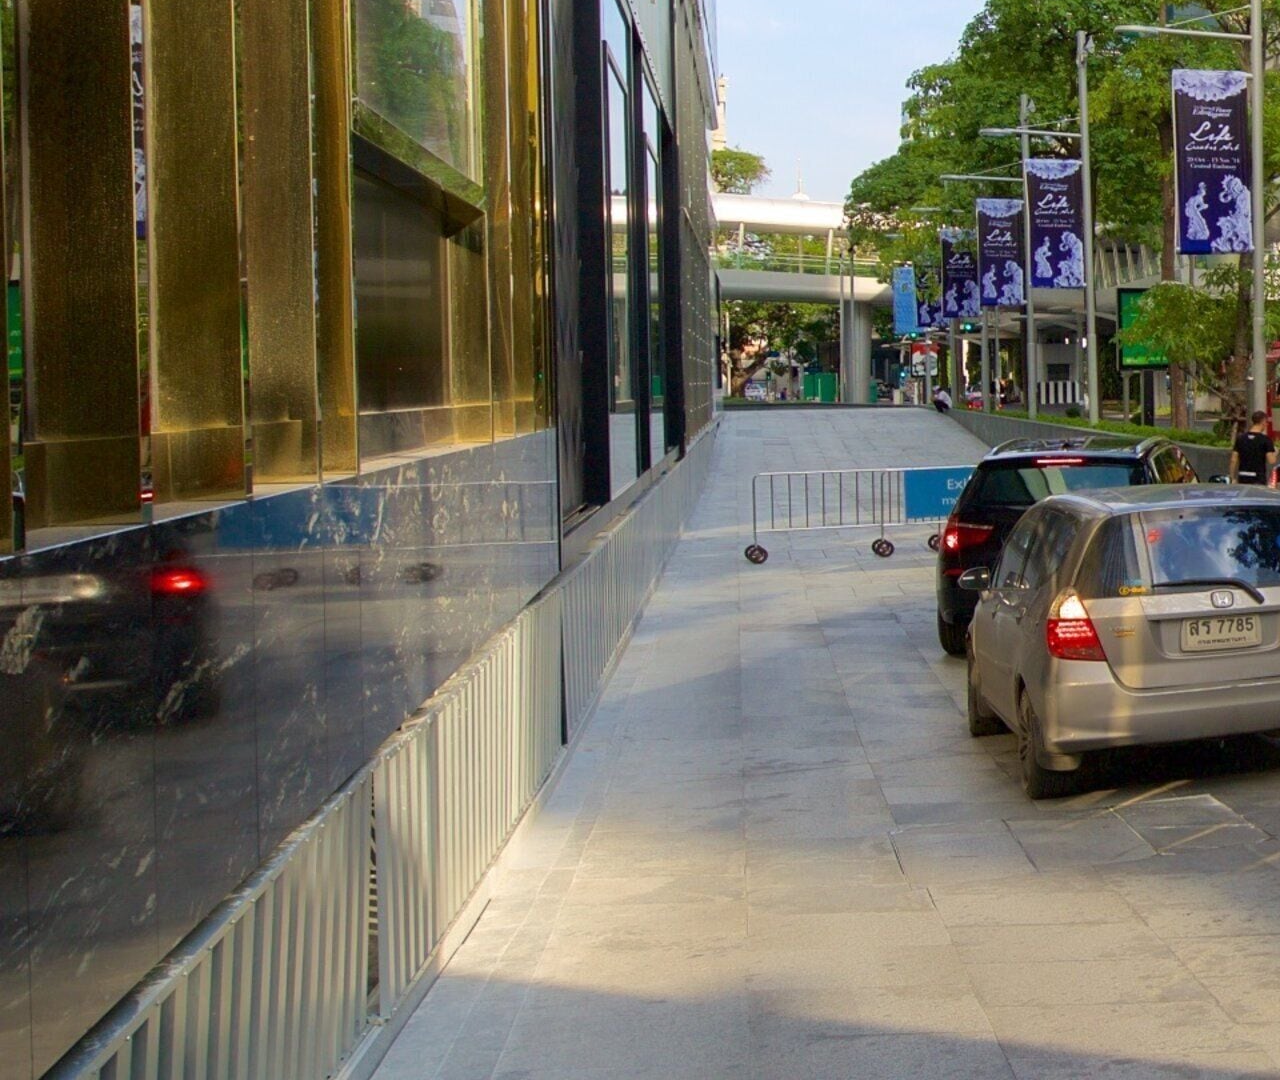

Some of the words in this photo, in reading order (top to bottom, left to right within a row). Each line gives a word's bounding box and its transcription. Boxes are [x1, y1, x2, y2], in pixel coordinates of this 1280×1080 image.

[1189, 121, 1235, 145] Life
[1037, 193, 1070, 210] Life
[986, 229, 1012, 243] Life
[1217, 618, 1254, 634] 7785
